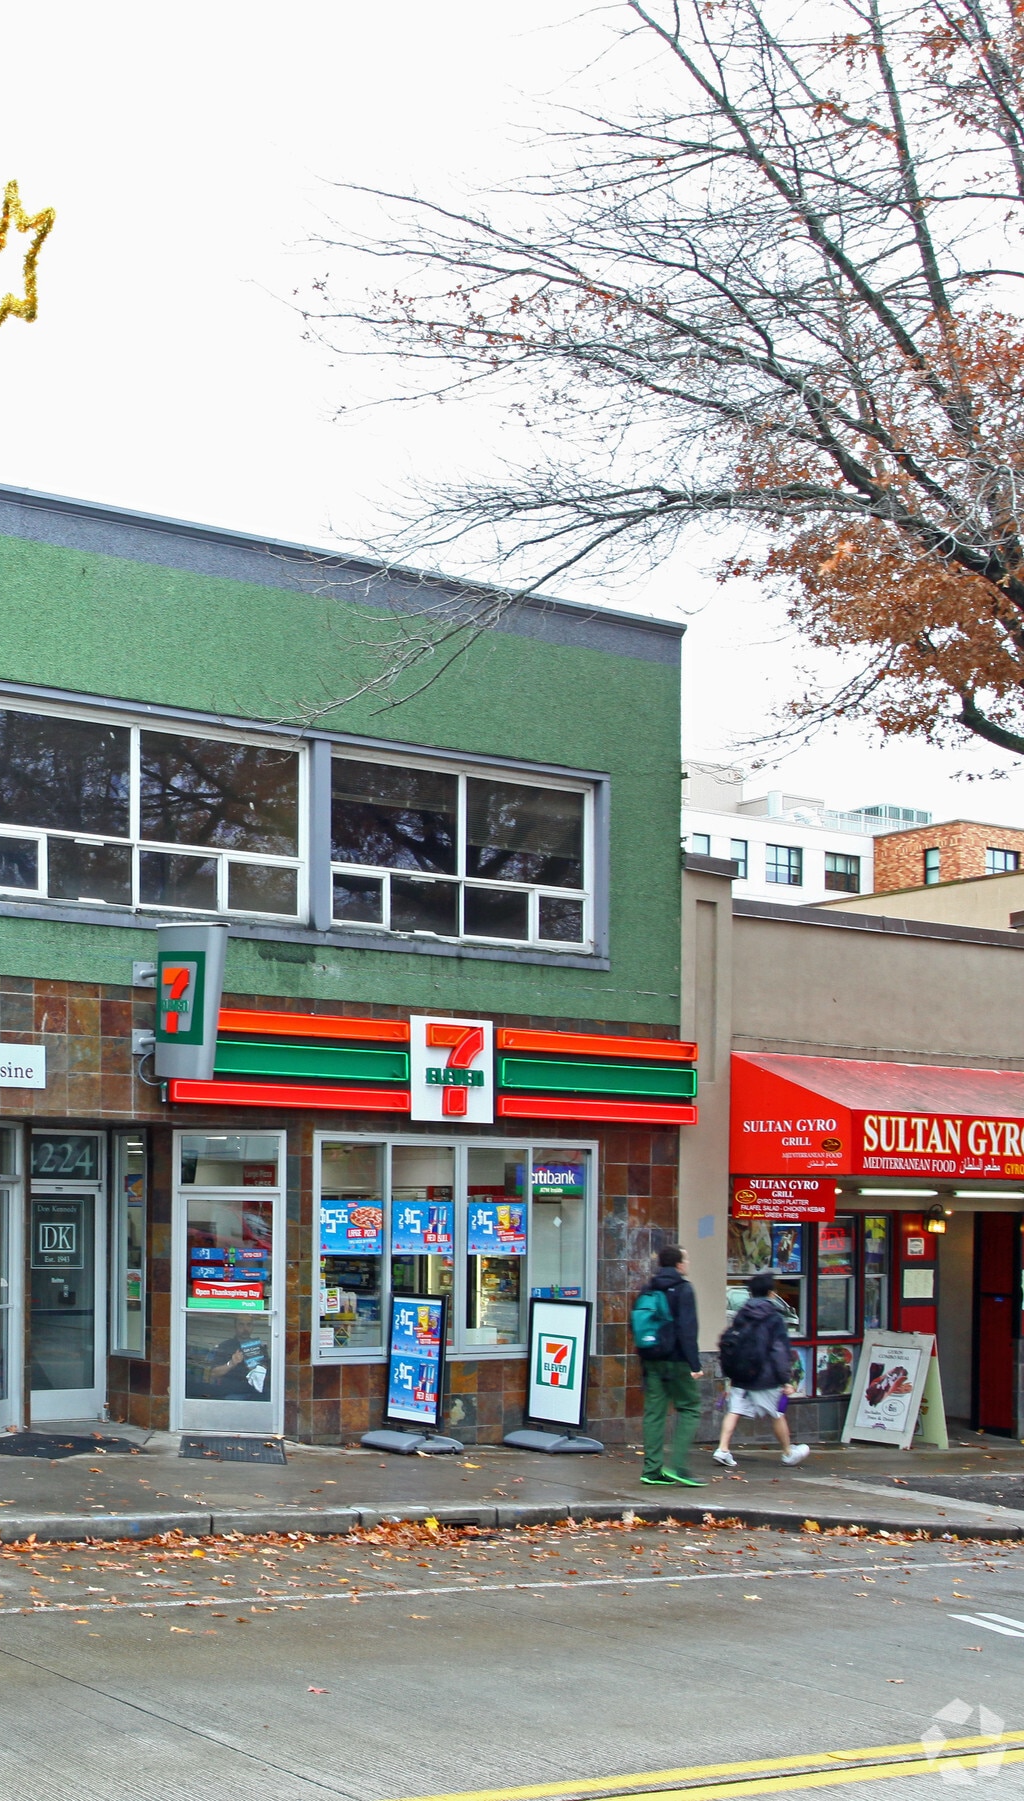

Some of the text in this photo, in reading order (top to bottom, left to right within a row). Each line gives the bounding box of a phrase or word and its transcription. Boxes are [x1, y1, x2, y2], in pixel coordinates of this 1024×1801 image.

[742, 1119, 837, 1132] SULTAN GYRO
[863, 1114, 1024, 1157] SULTAN GYR
[781, 1137, 812, 1146] GRILL
[863, 1157, 956, 1172] MEDITERRANEAN FOOD
[750, 1180, 819, 1190] SULTAN GYRO
[771, 1190, 794, 1198] GRILL
[44, 1226, 71, 1249] DK
[195, 1288, 260, 1298] Open Thanksgiving Day
